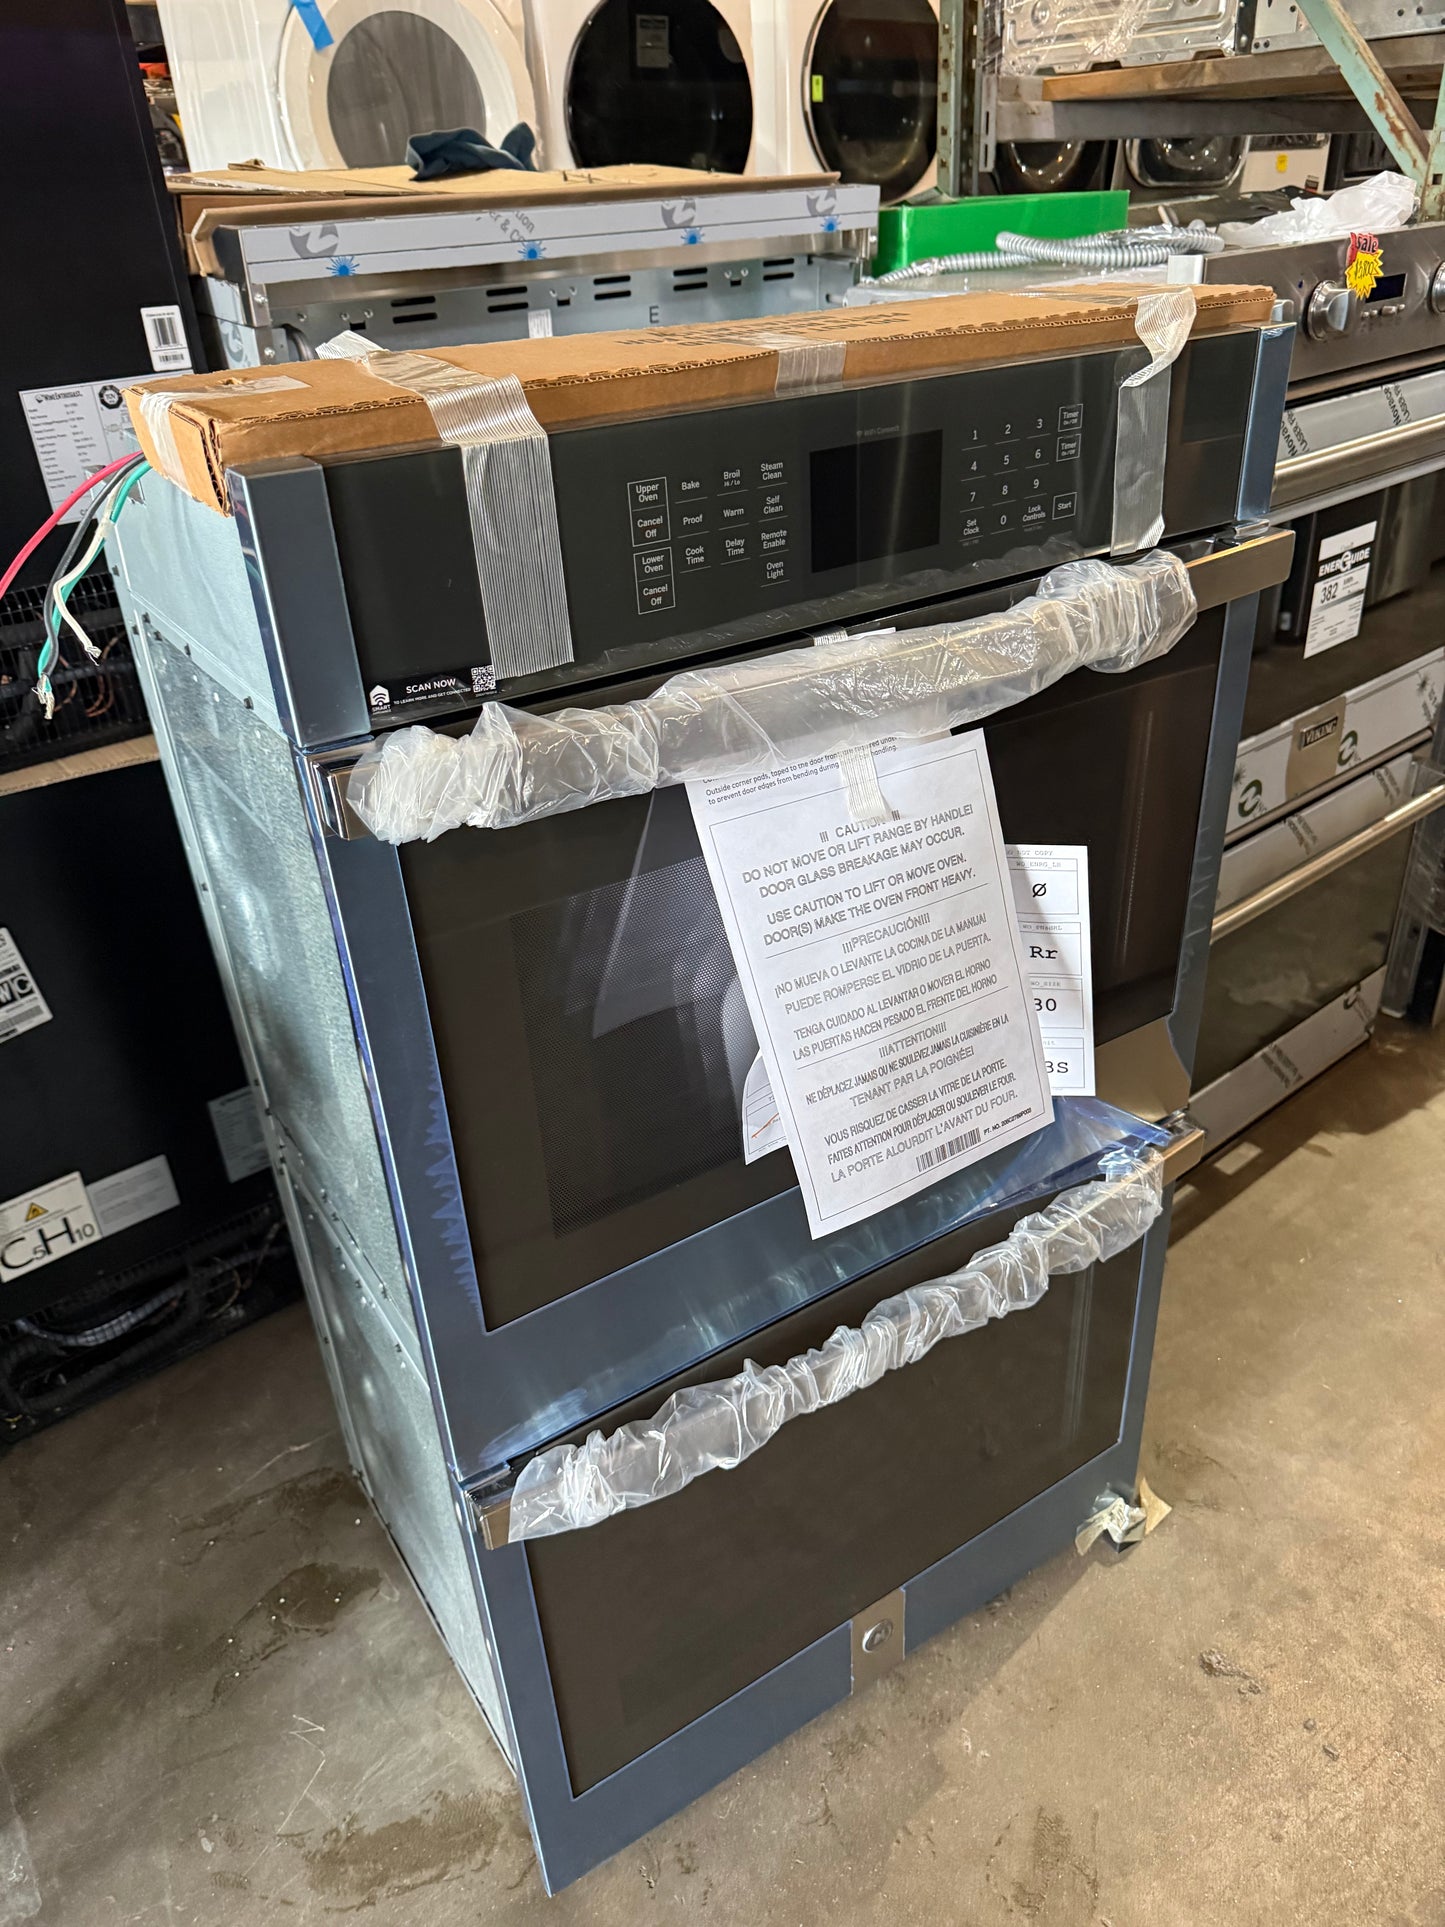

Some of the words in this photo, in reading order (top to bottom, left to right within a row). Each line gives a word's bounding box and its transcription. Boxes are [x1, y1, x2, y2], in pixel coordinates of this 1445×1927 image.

[1358, 236, 1377, 252] sale
[650, 306, 659, 324] E
[1005, 424, 1011, 435] 2
[1037, 419, 1043, 429] 3
[973, 430, 978, 440] 1
[1035, 449, 1041, 459] 6
[1004, 455, 1010, 465] 5
[760, 461, 783, 472] Steam
[971, 461, 977, 471] 4
[723, 469, 741, 479] Broil
[762, 470, 782, 481] Clean
[636, 482, 659, 495] Upper
[681, 480, 700, 491] Bake
[1033, 479, 1039, 489] 9
[1002, 485, 1008, 495] 8
[638, 492, 658, 502] Oven
[766, 495, 780, 505] Self
[970, 492, 976, 502] 7
[763, 503, 783, 514] Clean
[1028, 505, 1042, 514] Lock
[1057, 501, 1072, 511] Start
[723, 507, 744, 517] Warm
[1022, 511, 1046, 522] Controls
[637, 516, 663, 528] Cancel
[683, 514, 703, 525] Proof
[966, 519, 977, 527] Set
[1000, 515, 1007, 525] 0
[645, 528, 657, 538] Off
[761, 529, 787, 541] Remote
[963, 526, 980, 536] Clock
[725, 538, 745, 550] Delay
[763, 538, 786, 549] Enable
[685, 546, 704, 556] Cook
[727, 546, 745, 556] Time
[642, 554, 664, 565] Lower
[686, 554, 705, 565] Time
[1319, 548, 1370, 577] ENERGUIDE
[644, 564, 664, 573] Oven
[766, 561, 784, 570] Oven
[766, 569, 784, 579] Light
[643, 584, 668, 596] Cancel
[1321, 582, 1338, 604] 382
[650, 597, 662, 606] Off
[406, 684, 431, 694] SCAN
[433, 678, 456, 688] NOW
[1305, 717, 1337, 746] VIKING
[742, 869, 761, 884] DO
[763, 860, 788, 878] NOT
[791, 849, 826, 869] MOVE
[827, 843, 846, 858] OR
[847, 835, 870, 852] LIFT
[872, 823, 913, 844] RANGE
[914, 817, 928, 832] BY
[759, 878, 796, 898] DOOR
[797, 866, 836, 886] GLASS
[837, 846, 899, 874] BREAKAGE
[900, 837, 923, 855] MAY
[925, 826, 965, 846] OCCUR.
[767, 908, 792, 925] USE
[793, 892, 844, 917] CAUTION
[844, 886, 861, 900] TO
[863, 878, 885, 895] LIFT
[887, 873, 905, 887] OR
[905, 862, 936, 882] MOVE
[937, 853, 967, 870] OVEN.
[763, 921, 813, 946] DOOR(S)
[814, 910, 847, 930] MAKE
[847, 902, 872, 918] THE
[873, 891, 904, 910] OVEN
[905, 879, 939, 900] FRONT
[940, 868, 976, 888] HEAVY.
[794, 969, 830, 990] MUEVA
[830, 966, 839, 977] O
[840, 950, 884, 974] LEVANTE
[883, 946, 897, 959] LA
[897, 934, 931, 954] COCINA
[930, 928, 944, 942] DE
[944, 925, 956, 937] LA
[1030, 946, 1058, 959] Rr
[784, 993, 823, 1015] PUEDE
[822, 972, 882, 1002] ROMPERSE
[881, 969, 896, 982] EL
[895, 956, 928, 976] VIDRIO
[928, 950, 942, 964] DE
[942, 946, 956, 959] LA
[955, 932, 991, 954] PUERTA.
[793, 1021, 826, 1040] TENGA
[826, 1007, 866, 1030] CUIDADO
[867, 1003, 878, 1016] AL
[878, 987, 920, 1011] LEVANTAR
[919, 984, 927, 995] O
[926, 973, 955, 993] MOVER
[954, 970, 965, 982] EL
[964, 958, 991, 978] HORNO
[792, 1046, 811, 1061] LAS
[811, 1031, 853, 1055] PUERTAS
[852, 1019, 883, 1040] HACEN
[883, 1007, 916, 1028] PESADO
[915, 1003, 927, 1016] EL
[926, 990, 956, 1011] FRENTE
[955, 985, 972, 999] DEL
[970, 974, 997, 993] HORNO
[805, 1092, 818, 1105] NE
[878, 1064, 888, 1077] OU
[888, 1060, 899, 1073] NE
[951, 1034, 960, 1046] LA
[992, 1016, 1001, 1028] EN
[1000, 1013, 1009, 1025] LA
[849, 1081, 891, 1107] TENANT
[893, 1072, 915, 1090] PAR
[915, 1066, 929, 1080] LA
[824, 1128, 850, 1146] VOUS
[849, 1112, 886, 1137] RISQUEZ
[885, 1107, 898, 1121] DE
[898, 1094, 929, 1116] CASSER
[928, 1089, 940, 1102] LA
[938, 1079, 961, 1096] VITRE
[960, 1074, 972, 1087] DE
[971, 1070, 982, 1082] LA
[827, 1146, 854, 1165] FAITES
[854, 1128, 893, 1154] ATTENTION
[892, 1119, 913, 1137] POUR
[945, 1098, 956, 1112] OU
[956, 1084, 989, 1107] SOULEVER
[988, 1079, 998, 1092] LE
[831, 1168, 846, 1183] LA
[846, 1151, 884, 1176] PORTE
[886, 1127, 933, 1160] ALOURDIT
[934, 1108, 973, 1136] L'AVANT
[974, 1101, 989, 1117] DU
